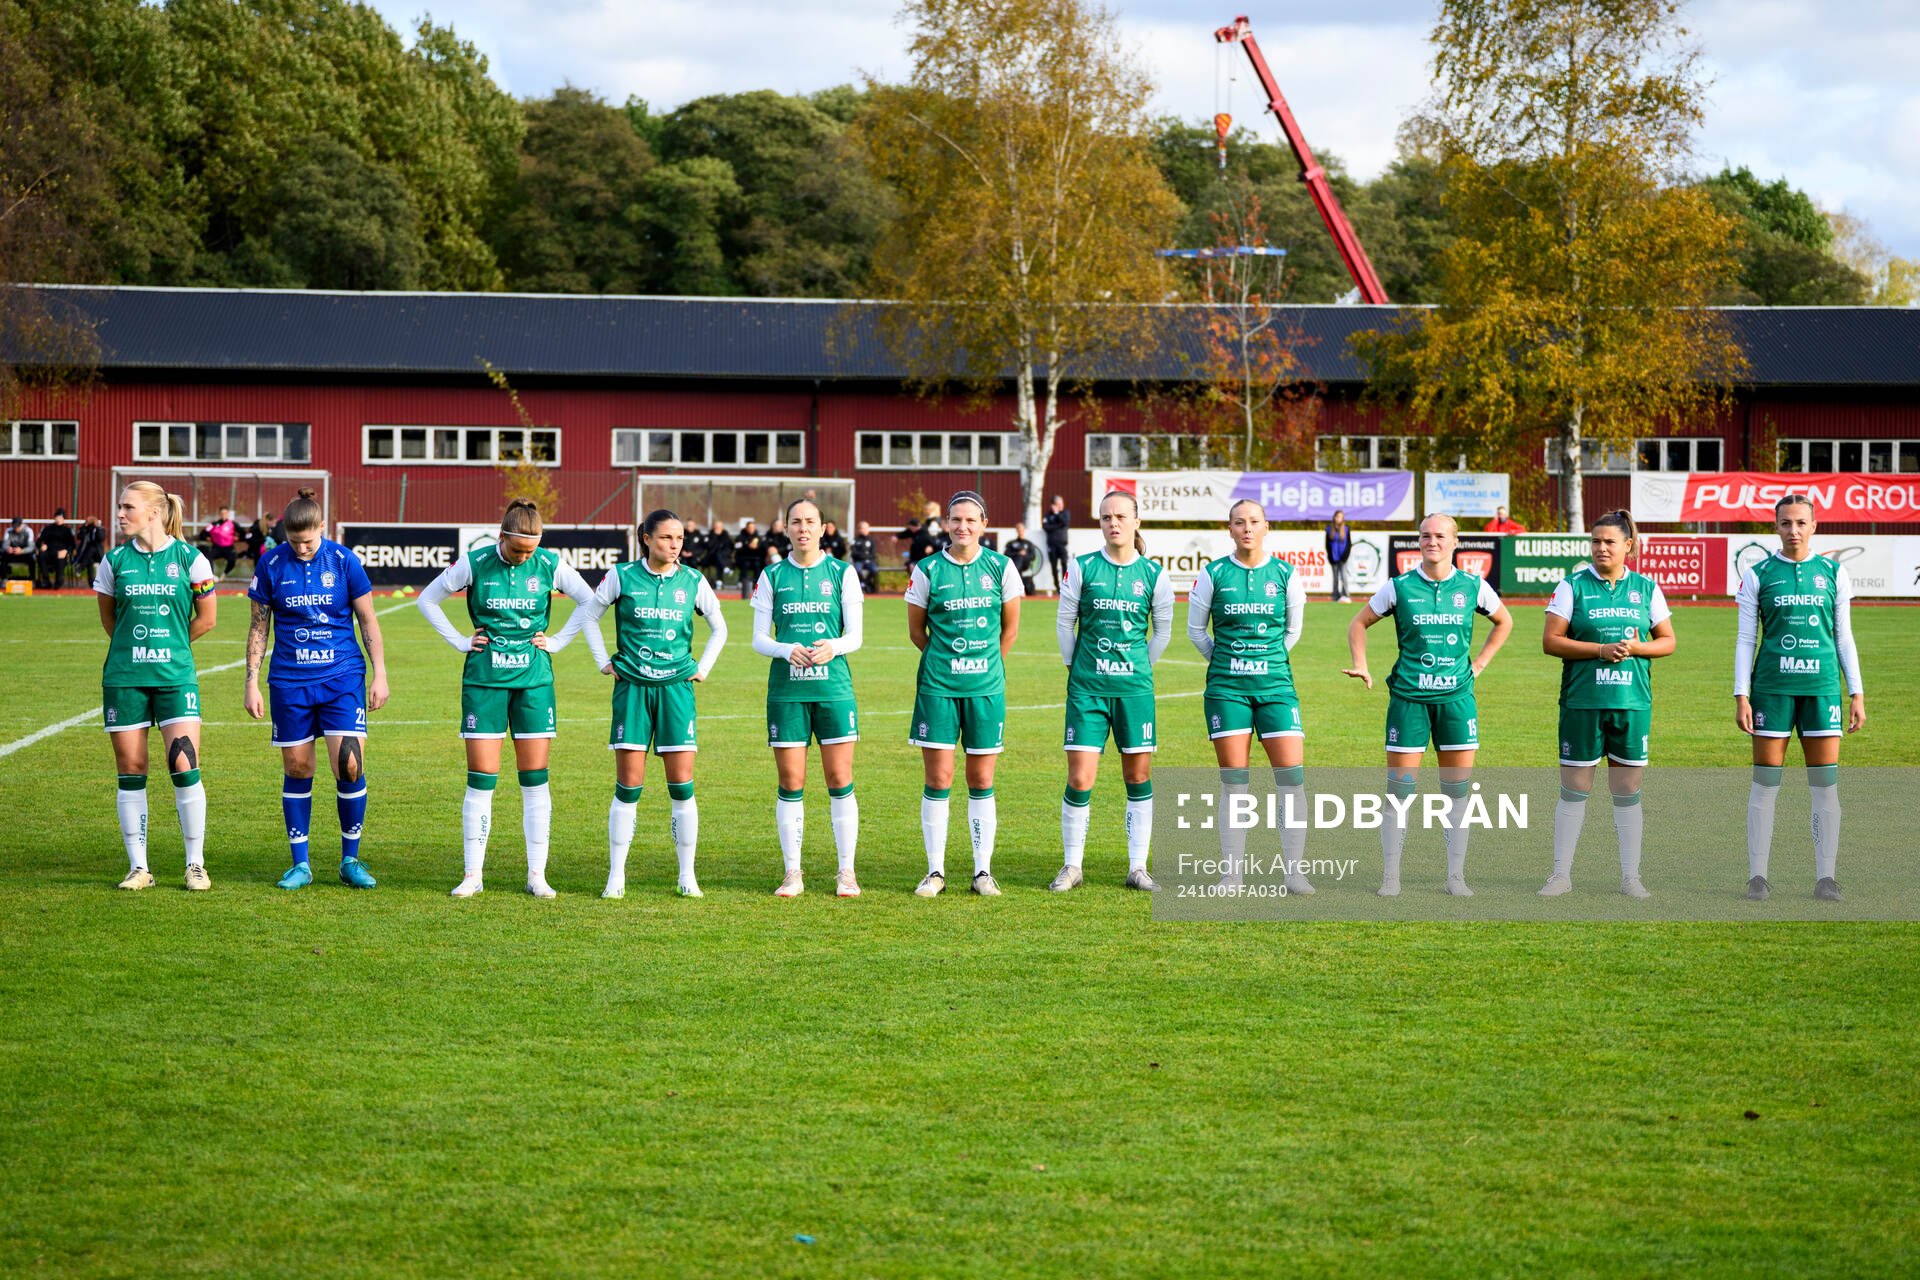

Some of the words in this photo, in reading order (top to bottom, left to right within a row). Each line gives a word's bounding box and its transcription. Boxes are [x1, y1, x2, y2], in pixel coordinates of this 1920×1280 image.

[1143, 485, 1212, 497] SVENSKA
[1260, 480, 1324, 512] Heja
[1329, 481, 1385, 507] alla!
[1143, 500, 1179, 511] SPEL
[353, 545, 453, 568] SERNEKE
[1642, 545, 1700, 555] PIZZERIA
[550, 546, 620, 570] NEKE
[1641, 558, 1700, 569] FRANCO
[1515, 568, 1565, 582] TIFOSI
[125, 584, 176, 596] SERNEKE
[285, 594, 333, 607] SERNEKE
[486, 598, 537, 610] SERNEKE
[943, 596, 992, 611] SERNEKE
[1093, 598, 1140, 613] SERNEKE
[1774, 595, 1824, 607] SERNEKE
[634, 607, 683, 621] SERNEKE
[782, 602, 830, 614] SERNEKE
[1224, 603, 1274, 615] SERNEKE
[1588, 607, 1641, 619] SERNEKE
[1412, 613, 1464, 625] SERNEKE
[132, 646, 171, 659] MAXI
[296, 649, 334, 660] MAXI
[492, 651, 530, 663] MAXI
[952, 658, 988, 671] MAXI
[1096, 658, 1134, 671] MAXI
[1230, 658, 1268, 671] MAXI
[1780, 656, 1820, 669] MAXI
[1419, 673, 1457, 685] MAXI
[1596, 668, 1633, 681] MAXI
[185, 692, 197, 709] 12
[548, 707, 554, 725] 3
[1291, 707, 1300, 726] 11
[1828, 705, 1841, 722] 20
[687, 720, 695, 738] 4
[1142, 722, 1152, 739] 10
[1466, 718, 1477, 736] 15
[139, 814, 147, 838] CRAFT
[972, 818, 980, 840] CRAFT
